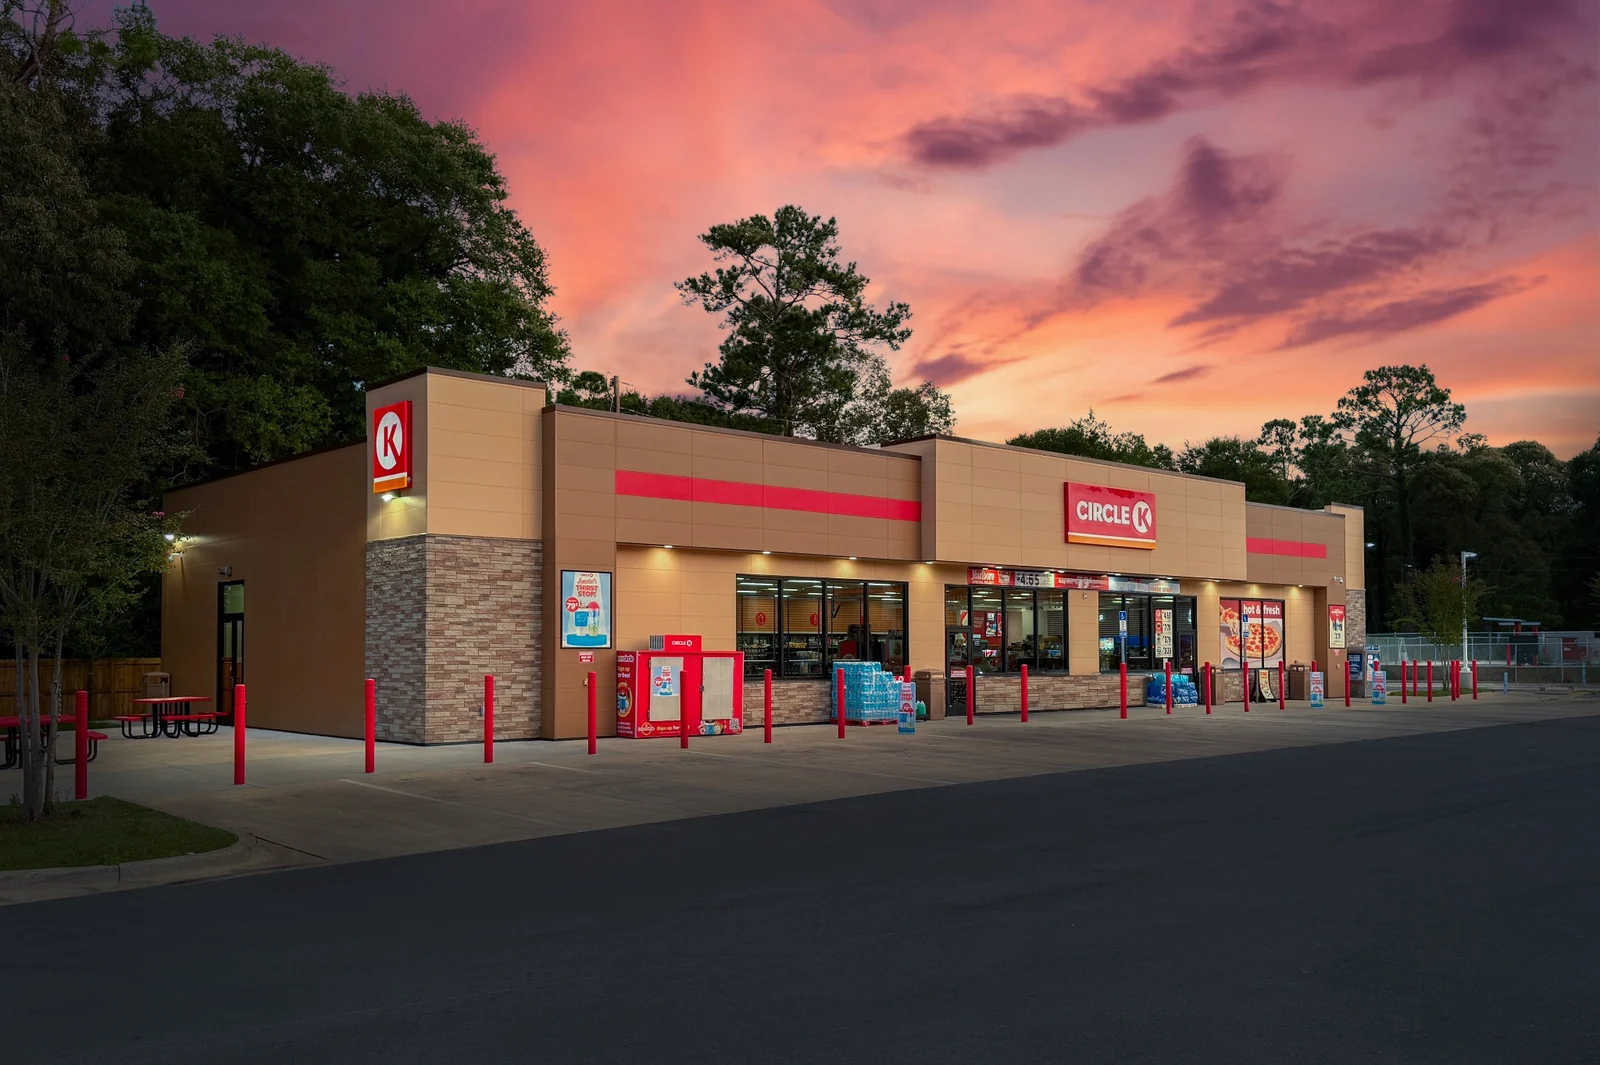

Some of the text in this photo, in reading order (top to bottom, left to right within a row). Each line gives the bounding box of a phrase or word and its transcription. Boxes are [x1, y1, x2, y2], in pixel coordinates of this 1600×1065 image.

[382, 420, 402, 466] K
[1076, 500, 1152, 531] CIRCLE K
[1243, 604, 1280, 615] hot & fresh
